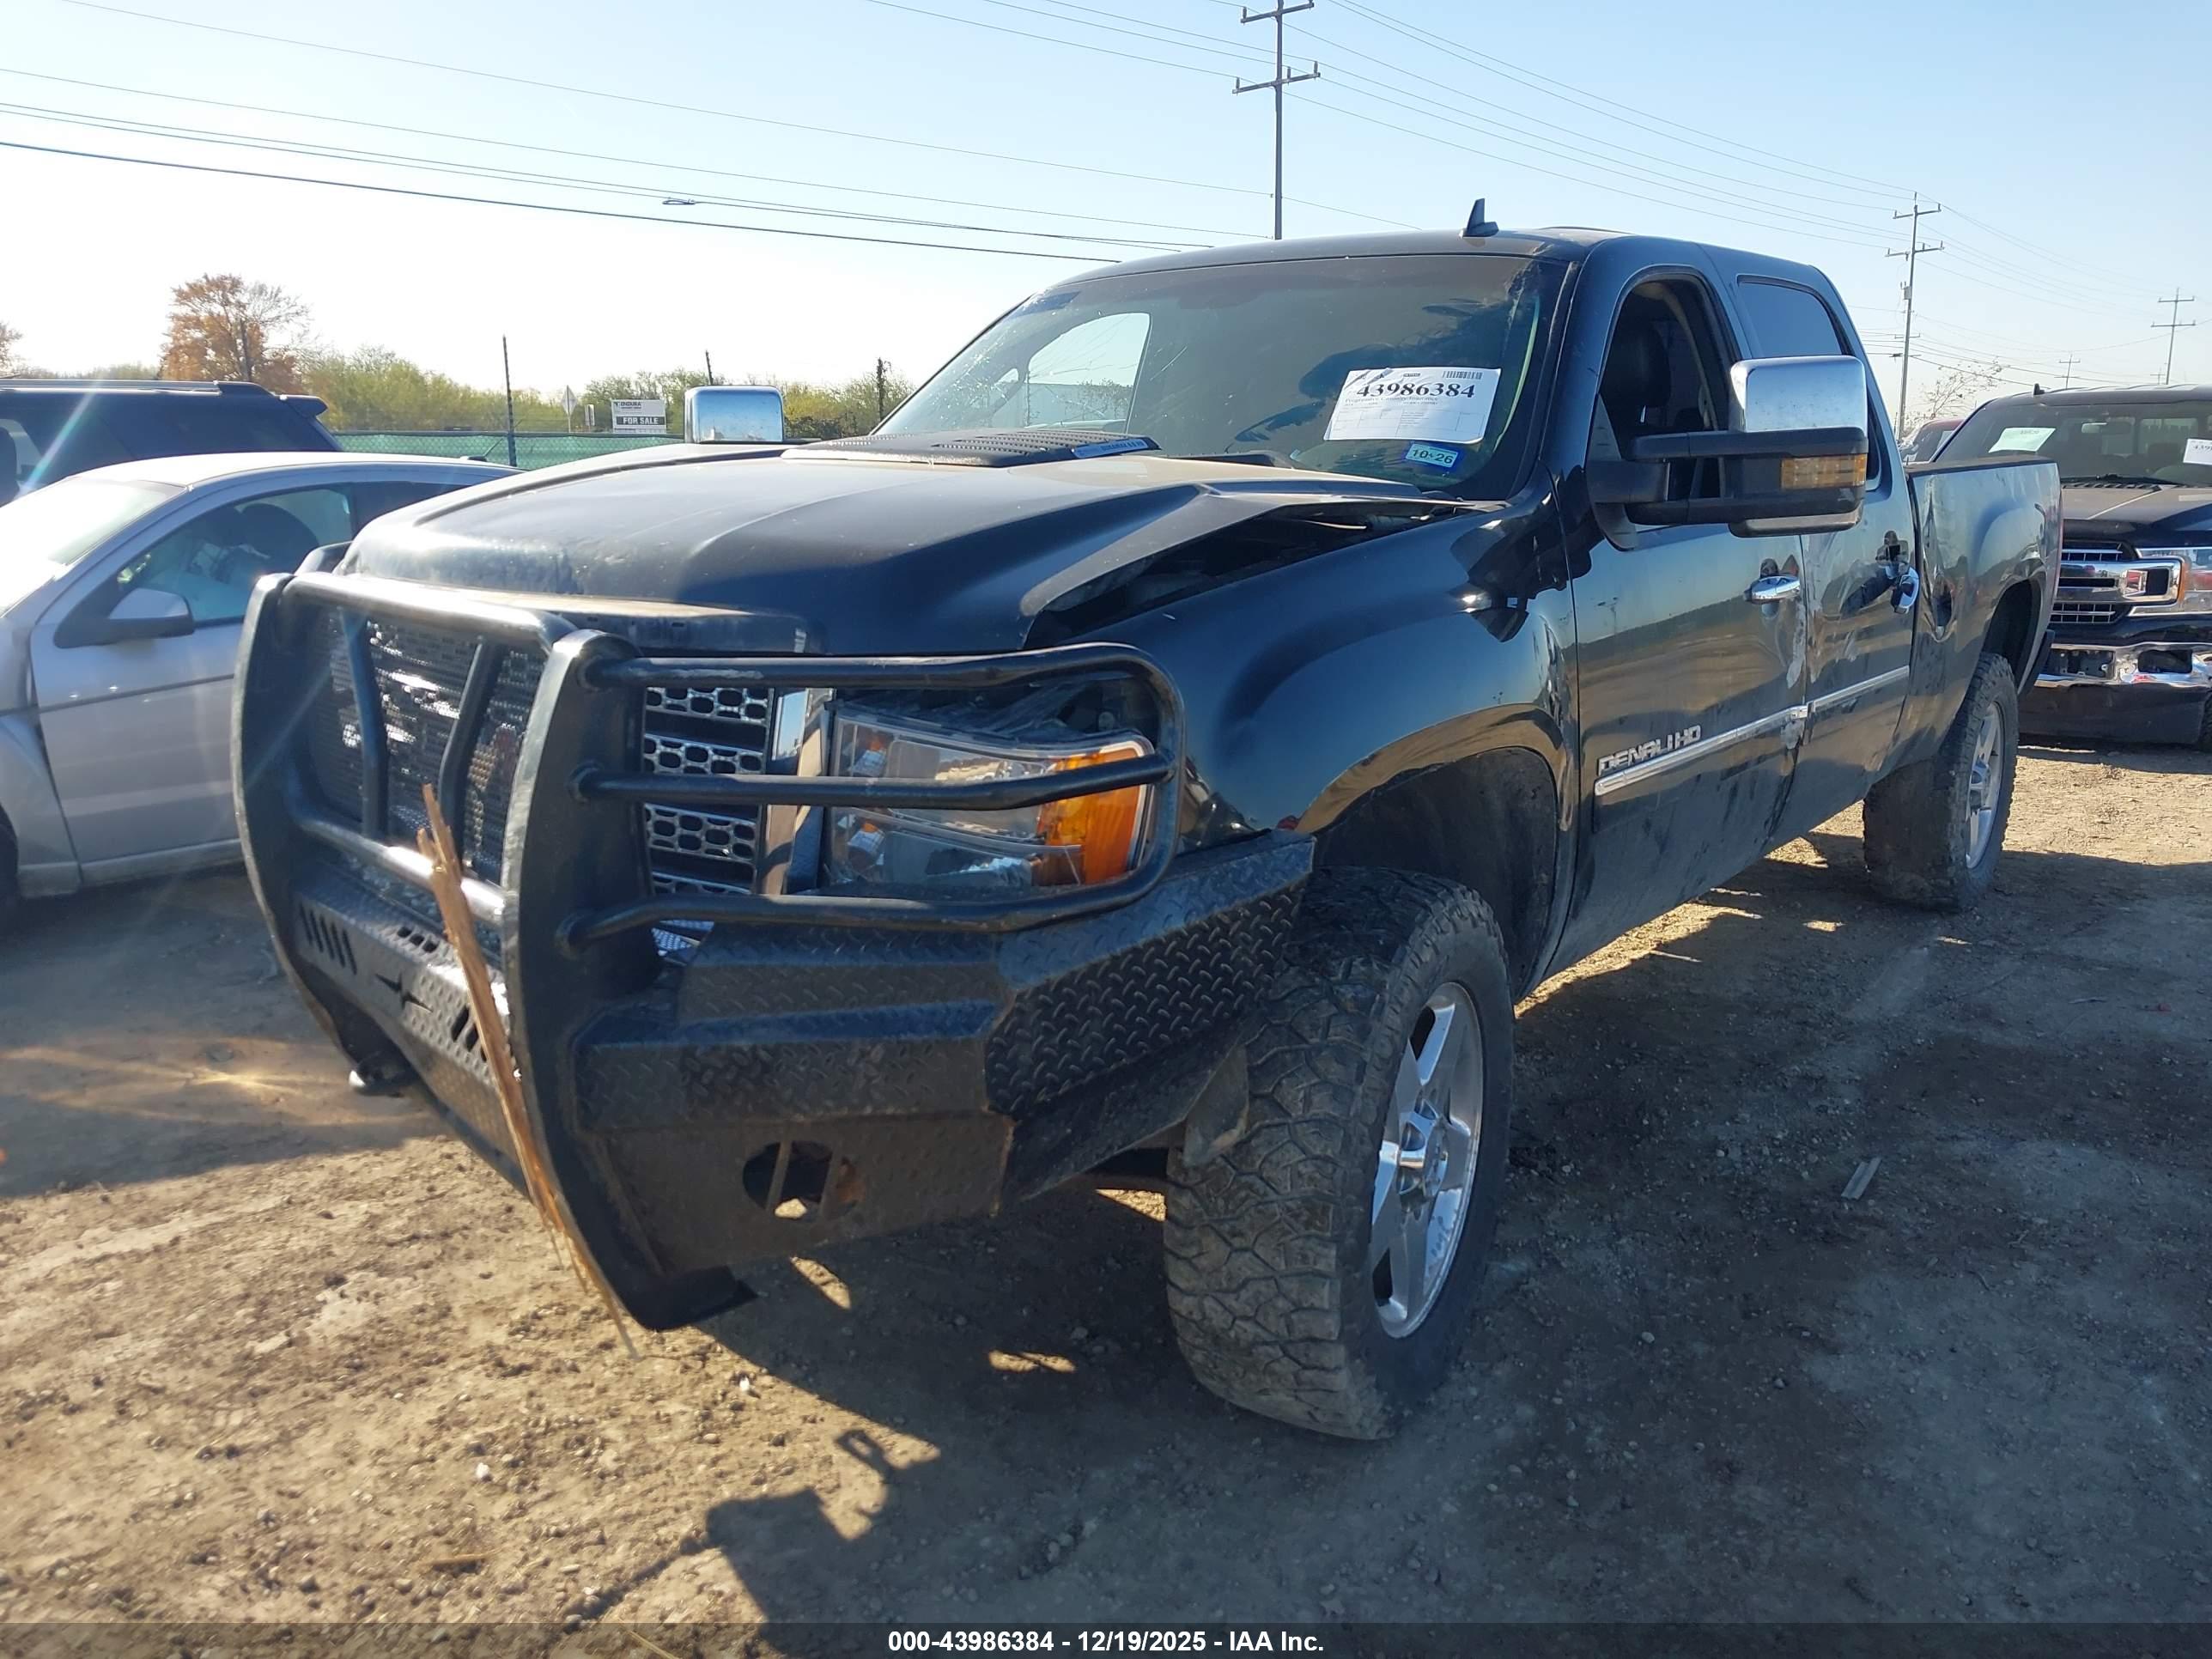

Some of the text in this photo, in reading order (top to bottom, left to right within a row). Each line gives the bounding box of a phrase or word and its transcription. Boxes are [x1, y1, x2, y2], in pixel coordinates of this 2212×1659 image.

[1357, 382, 1475, 398] 43986384
[1597, 725, 1701, 777] DENALI HD
